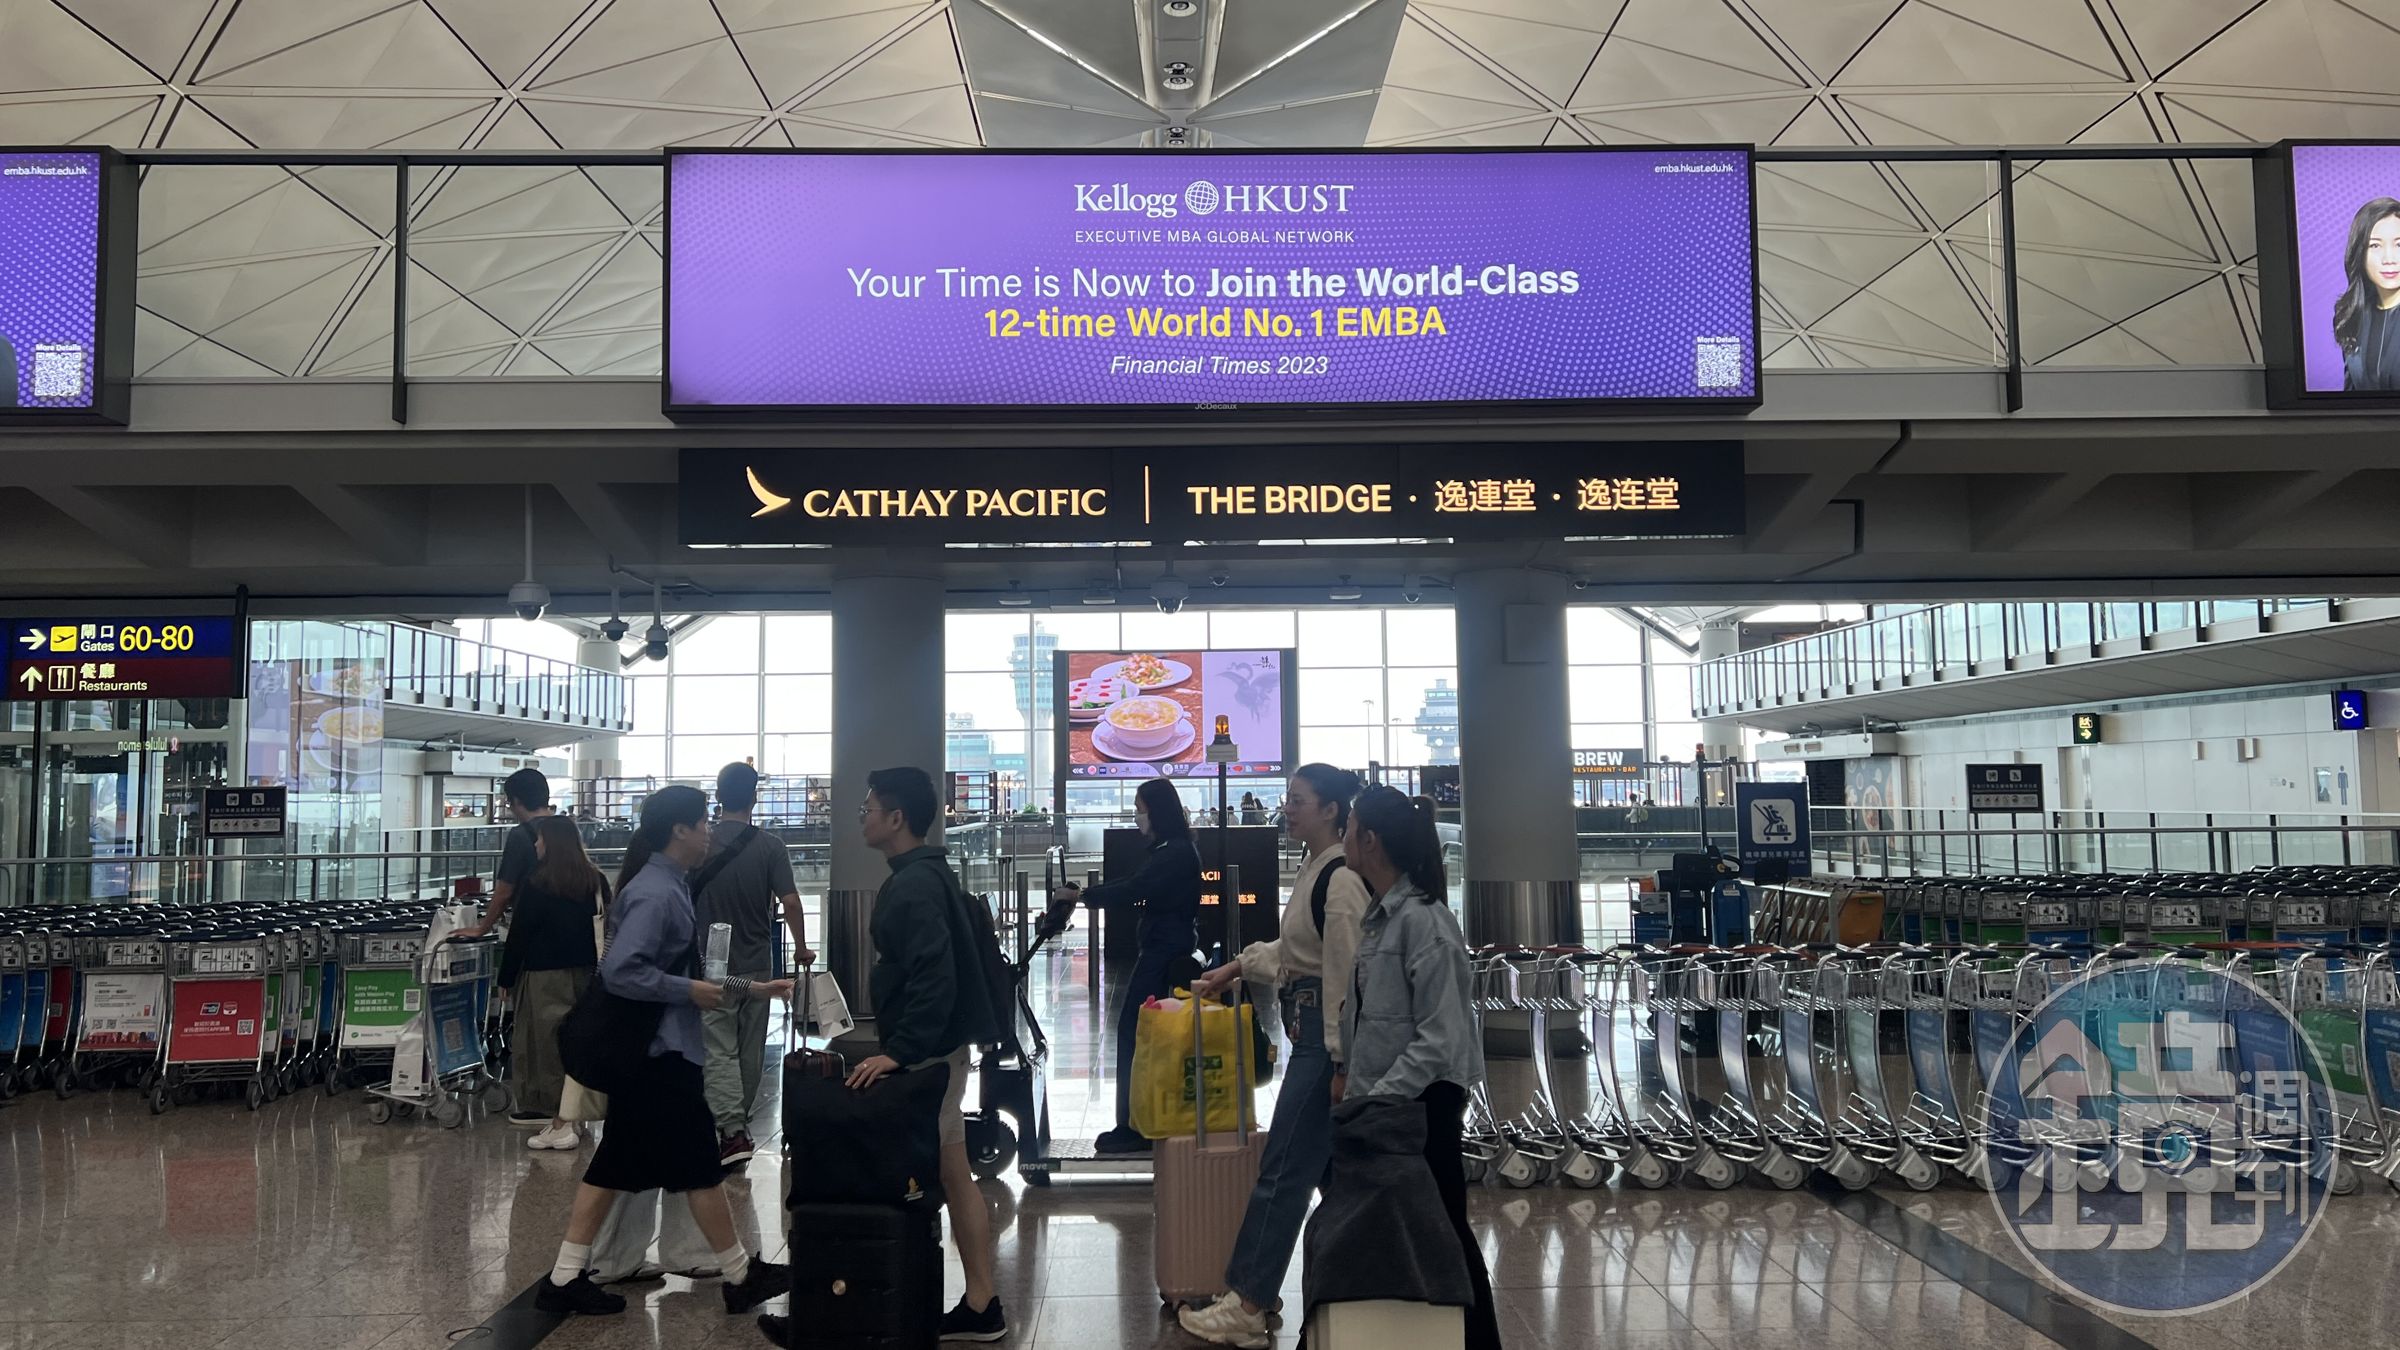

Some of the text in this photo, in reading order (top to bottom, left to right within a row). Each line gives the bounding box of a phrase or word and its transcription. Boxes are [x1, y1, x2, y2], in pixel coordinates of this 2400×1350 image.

[3, 165, 88, 176] emba.hkust.edu.hk
[1654, 163, 1735, 174] emba.hkust.edu.hk
[1074, 183, 1354, 218] Kellogg HKUST
[1075, 230, 1354, 243] EXECUTIVE MBA GLOBAL NETWORK
[847, 264, 1580, 298] Your Time is Now to Join the World-Class
[984, 305, 1448, 338] 12-time World No. 1 EMBA
[1110, 355, 1328, 375] Financial Times 2023
[1194, 402, 1238, 410] JCDecaux
[1187, 476, 1681, 514] THE BRIDGE 逸連堂 逸连堂
[803, 488, 1107, 518] CATHAY PACIFIC
[80, 624, 114, 639] 閘口
[119, 624, 194, 651] 60-80
[80, 641, 115, 652] Gates
[80, 663, 116, 679] 餐廳
[78, 680, 148, 692] Restaurants
[1574, 751, 1624, 767] BREW
[1622, 766, 1637, 774] BAR
[1020, 1163, 1047, 1171] move
